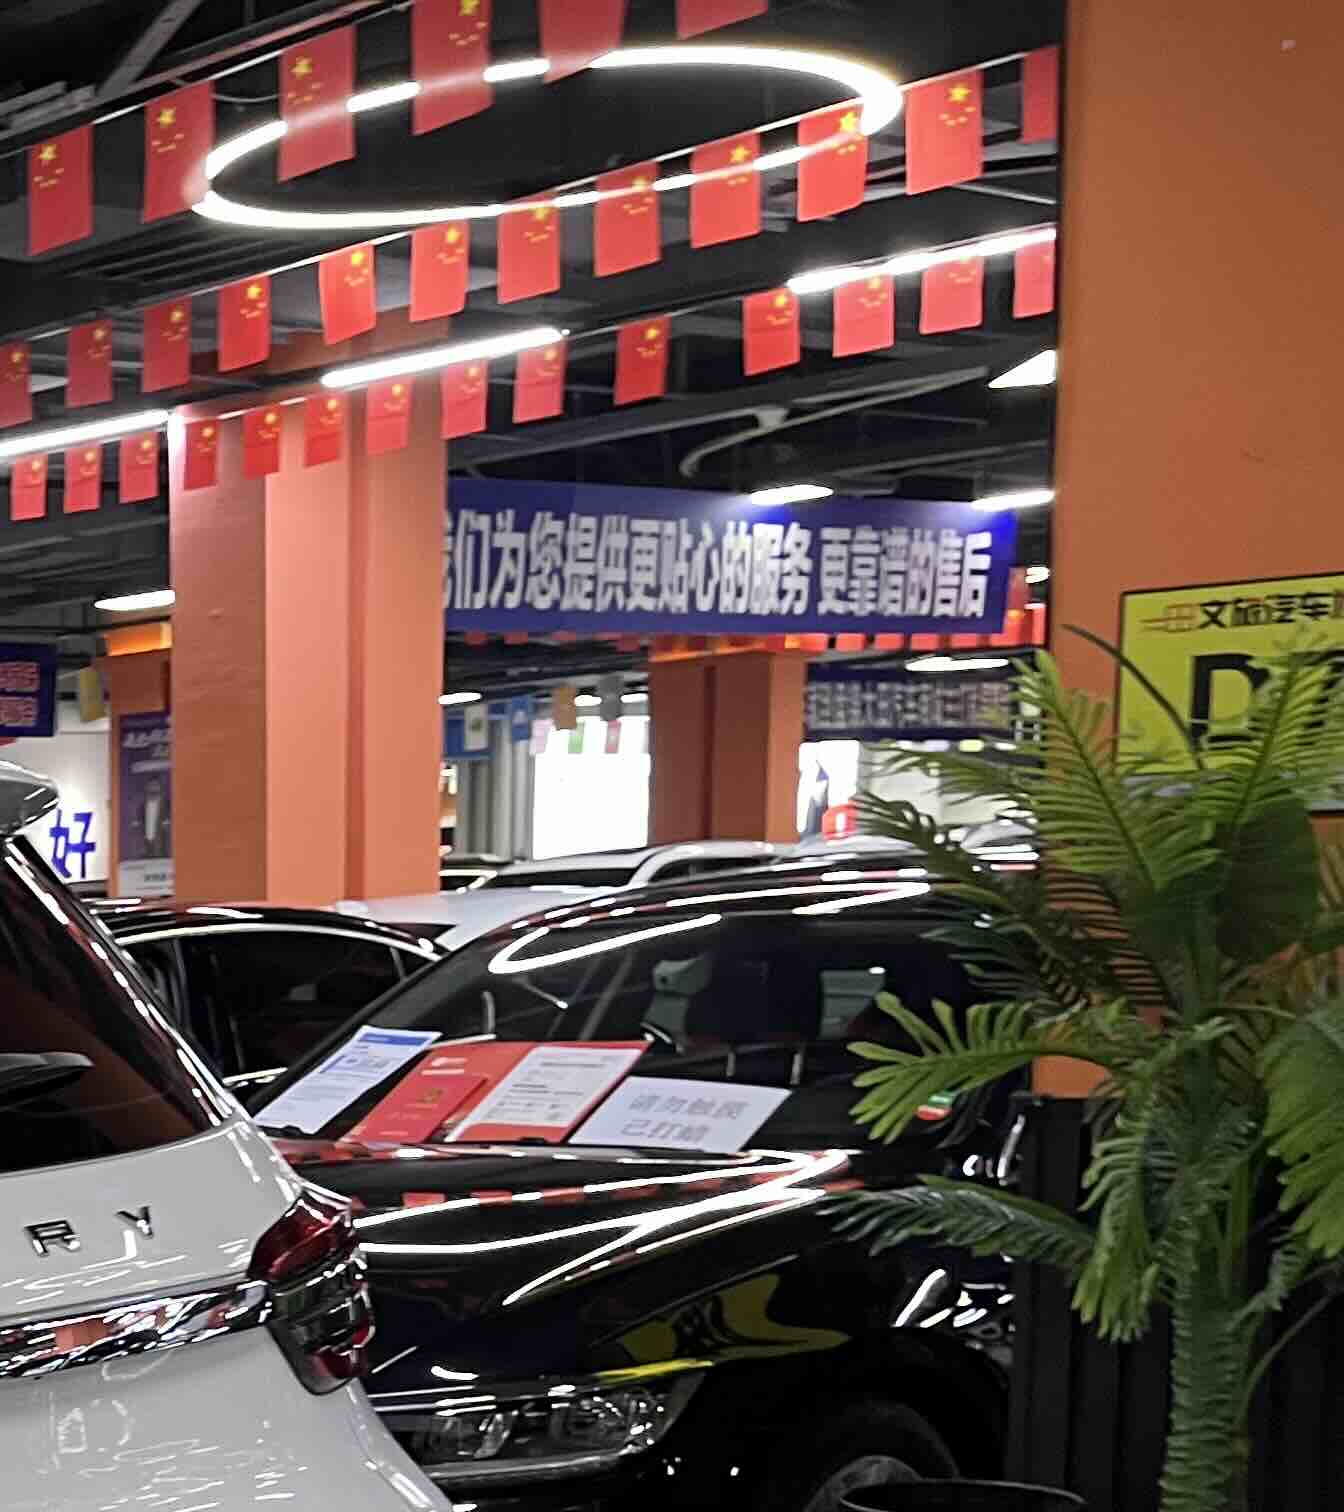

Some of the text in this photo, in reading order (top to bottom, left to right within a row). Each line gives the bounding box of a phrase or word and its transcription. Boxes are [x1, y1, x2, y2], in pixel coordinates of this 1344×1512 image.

[443, 510, 993, 617] 们为您提供更贴心的服务 更靠谱的售后
[49, 808, 96, 879] 好
